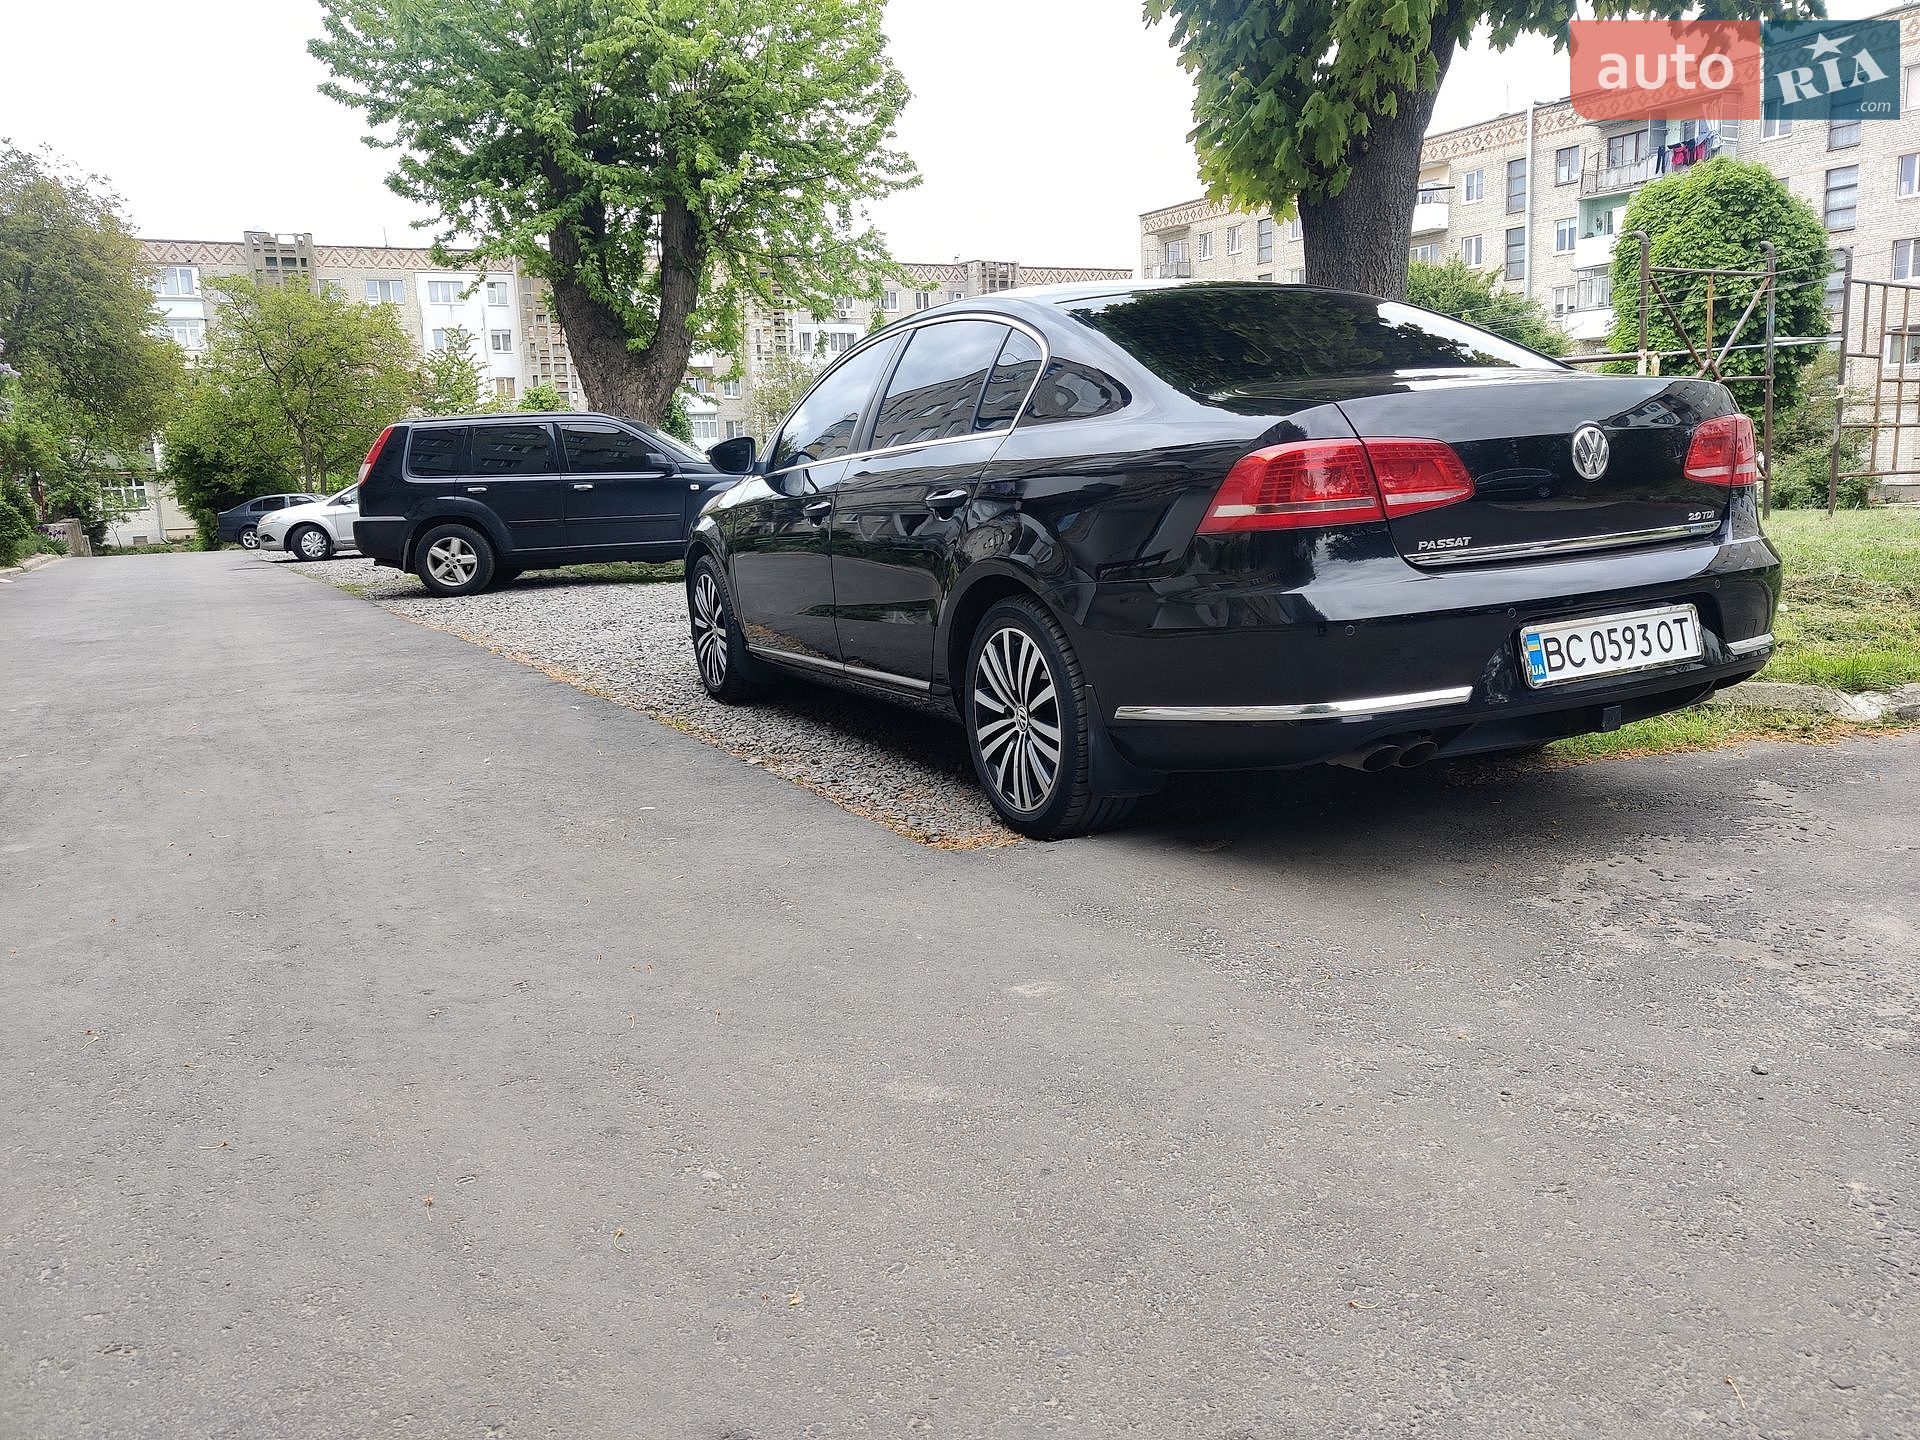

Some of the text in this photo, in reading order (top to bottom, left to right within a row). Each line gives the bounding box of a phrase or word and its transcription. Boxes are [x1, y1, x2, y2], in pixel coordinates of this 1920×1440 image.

[1417, 536, 1472, 551] PASSAT
[1543, 617, 1688, 672] BC 0593 OT
[1531, 663, 1545, 676] UA
